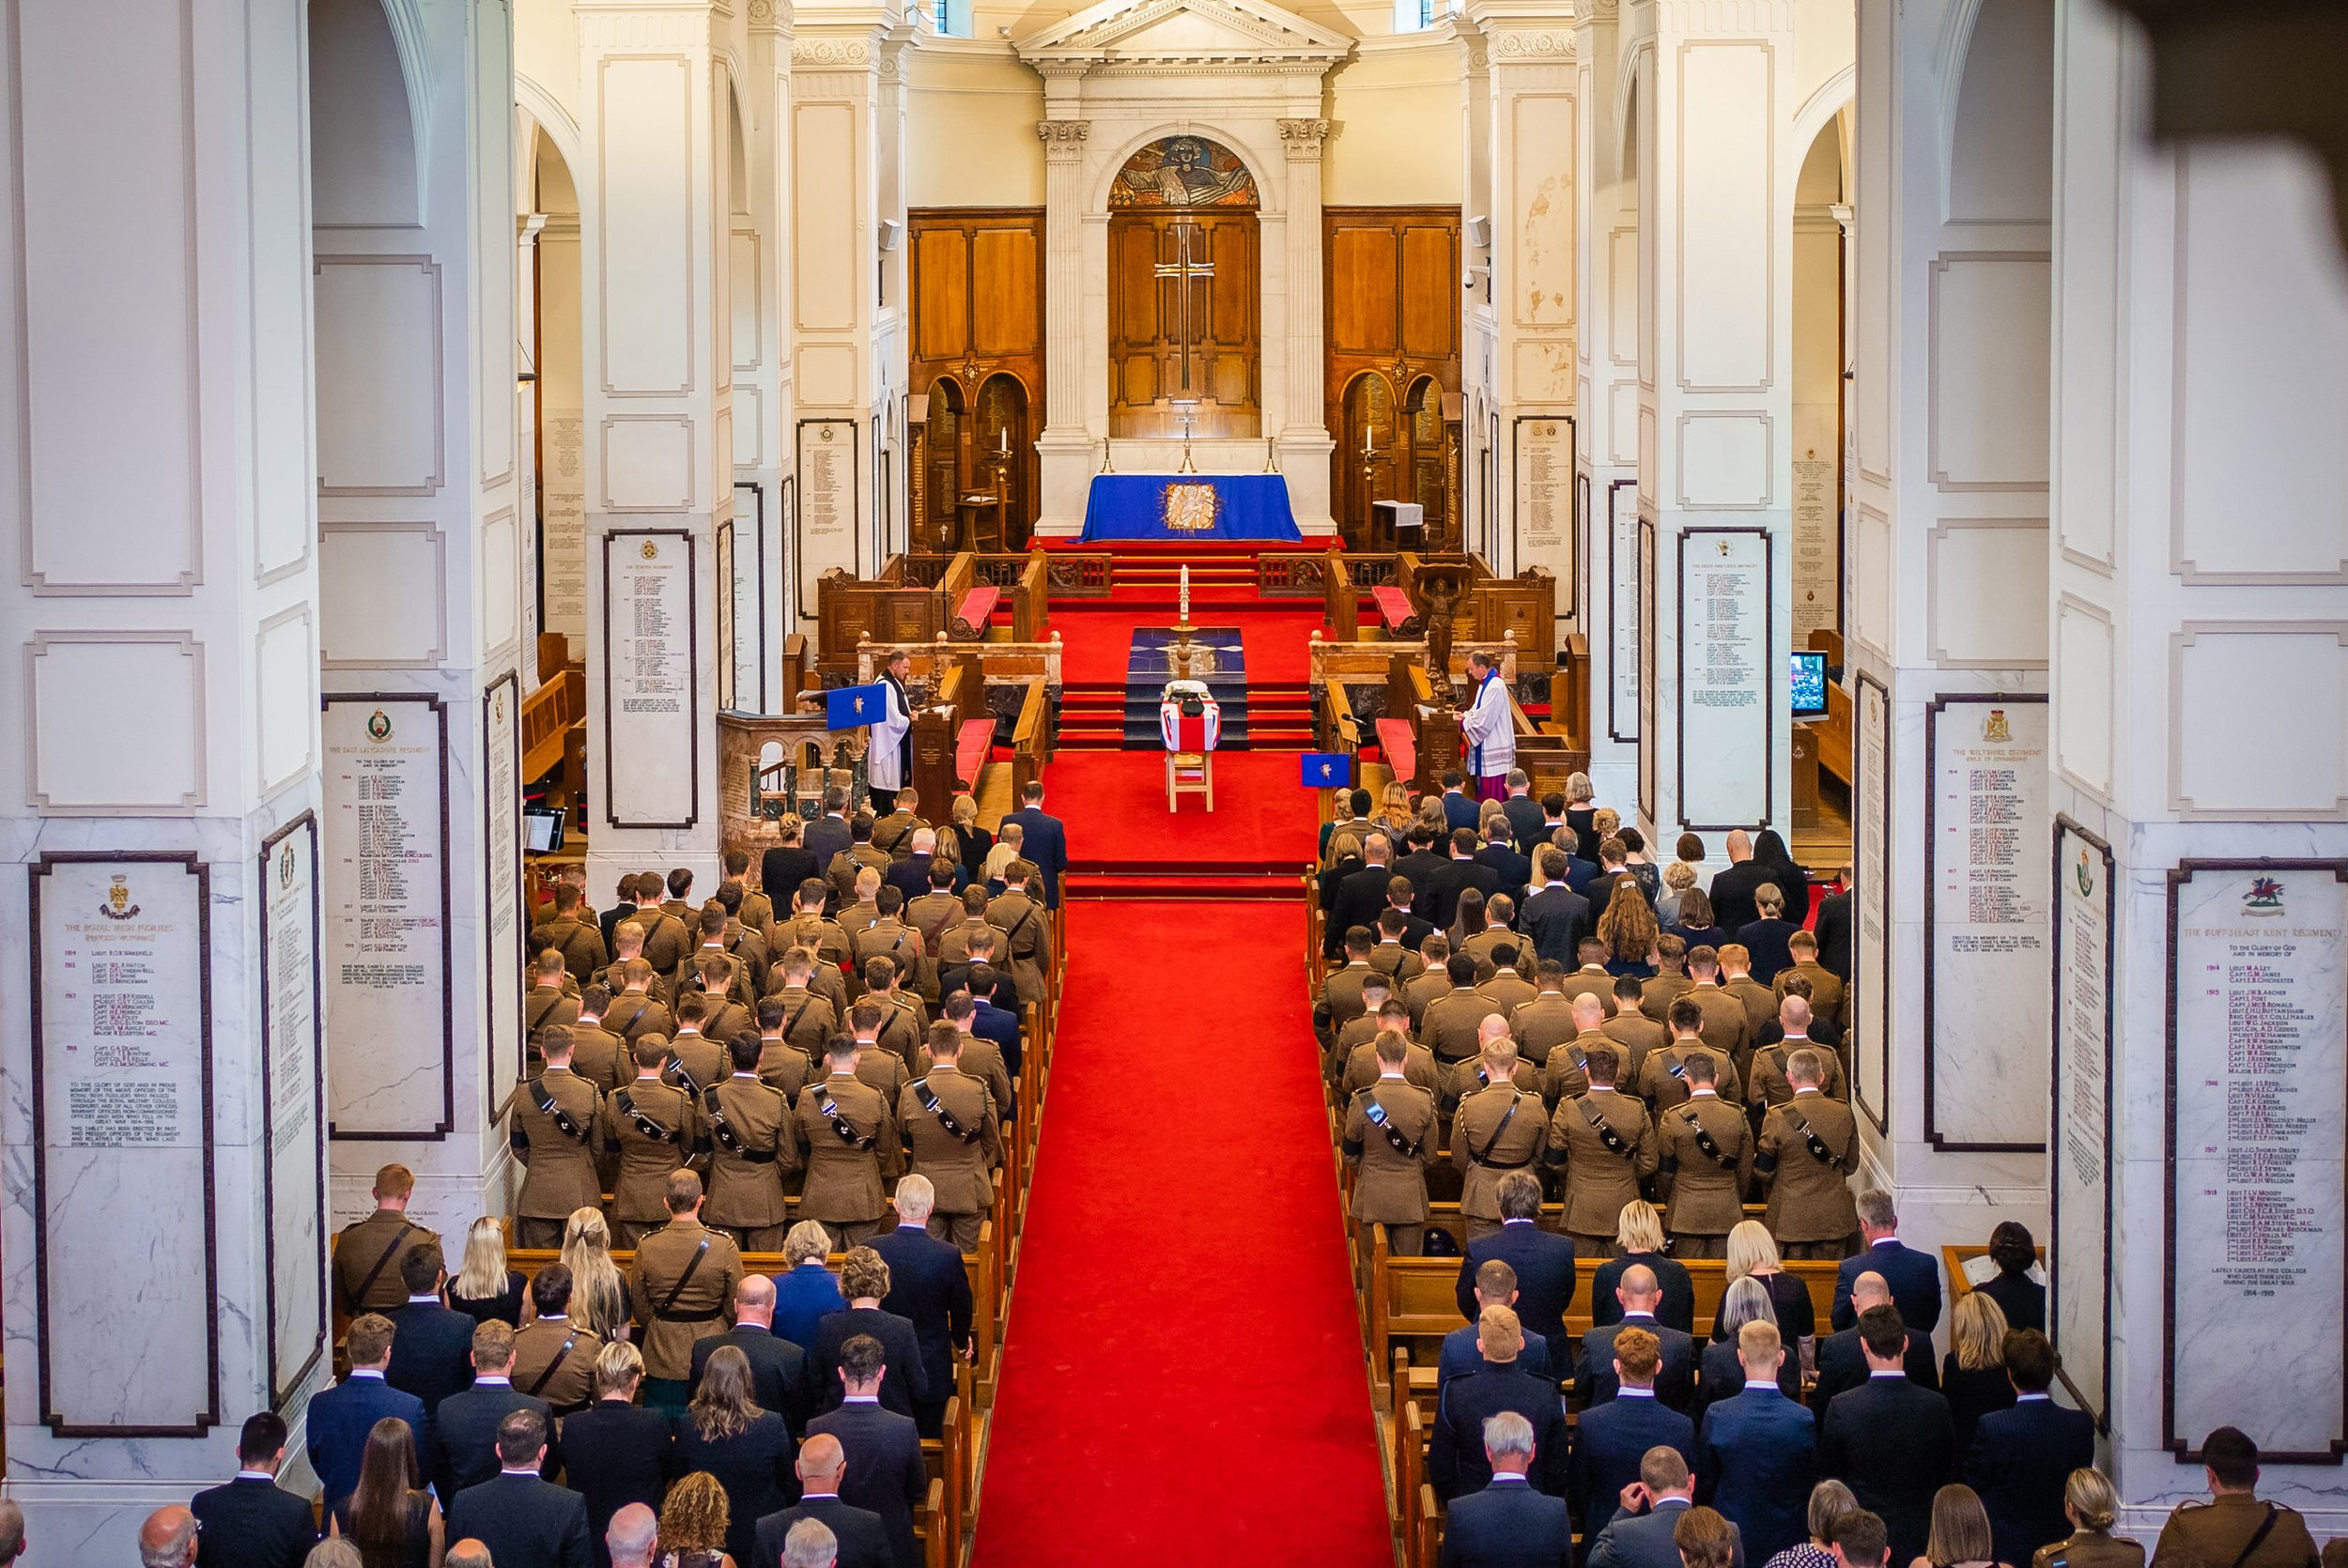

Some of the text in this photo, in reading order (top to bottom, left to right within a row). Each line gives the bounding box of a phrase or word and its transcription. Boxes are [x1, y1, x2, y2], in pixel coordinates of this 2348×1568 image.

[66, 924, 81, 932] THE
[2185, 929, 2200, 937] THE
[2263, 929, 2286, 937] KENT
